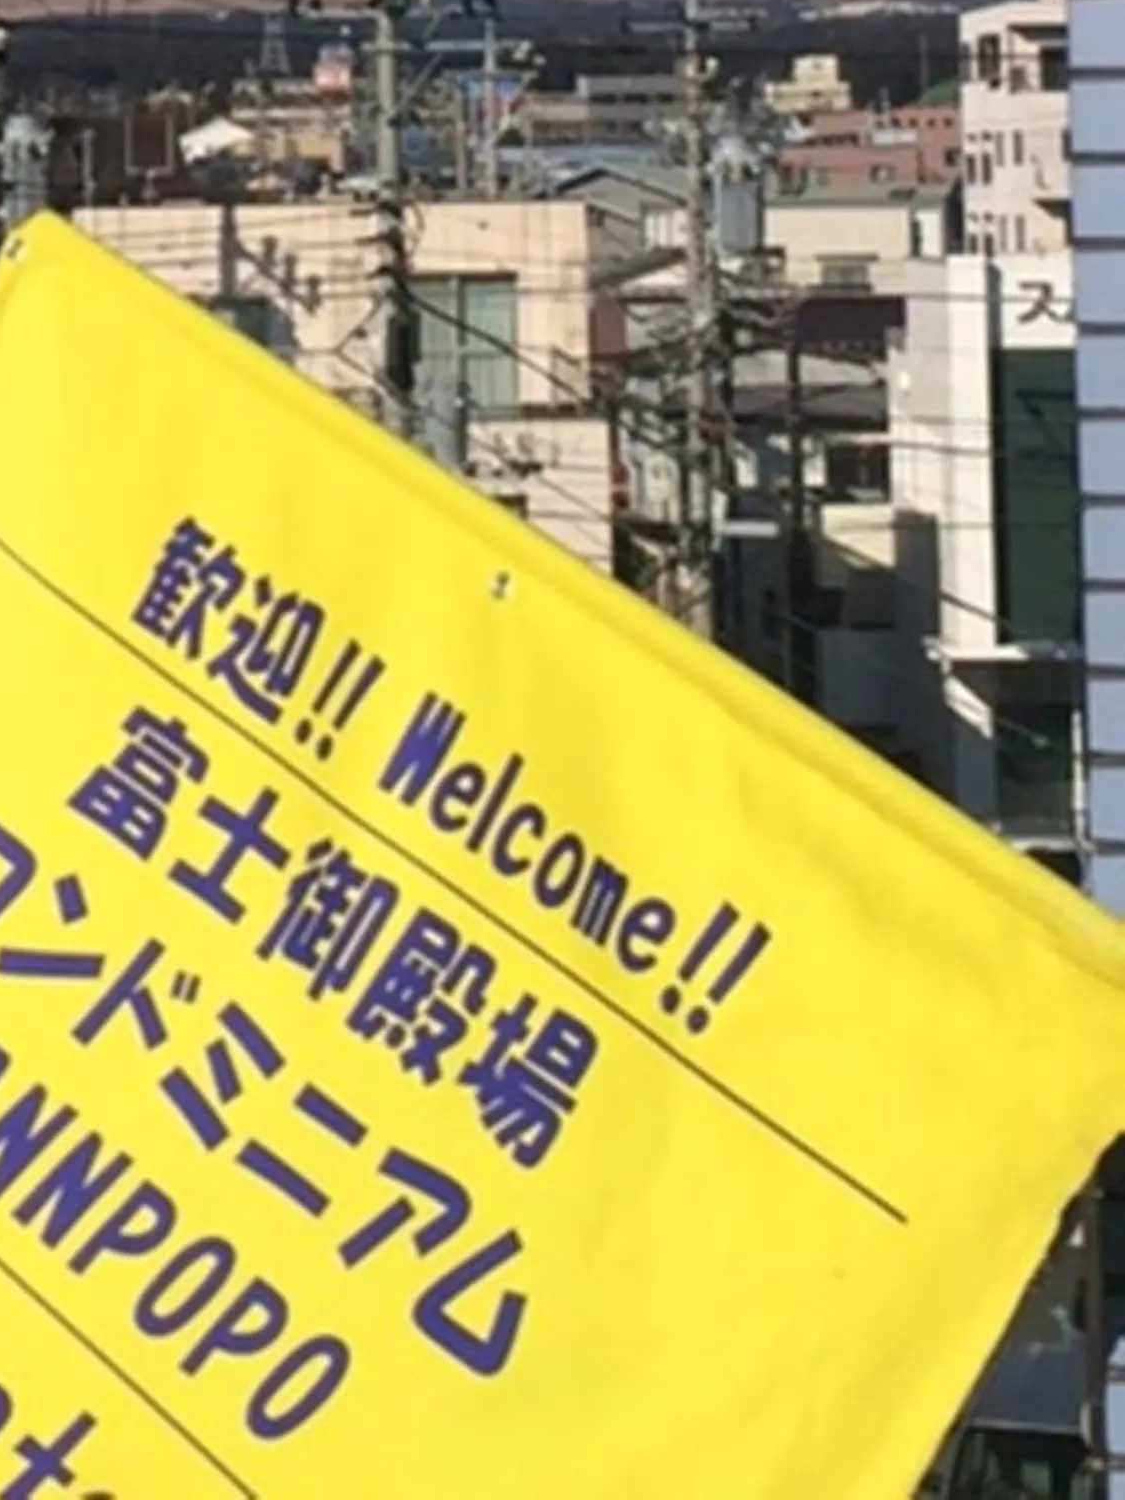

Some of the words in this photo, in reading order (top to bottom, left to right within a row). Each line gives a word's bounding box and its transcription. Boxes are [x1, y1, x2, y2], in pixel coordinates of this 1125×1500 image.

[67, 705, 599, 1169] 富士御殿場
[377, 692, 772, 1035] Welcome!!
